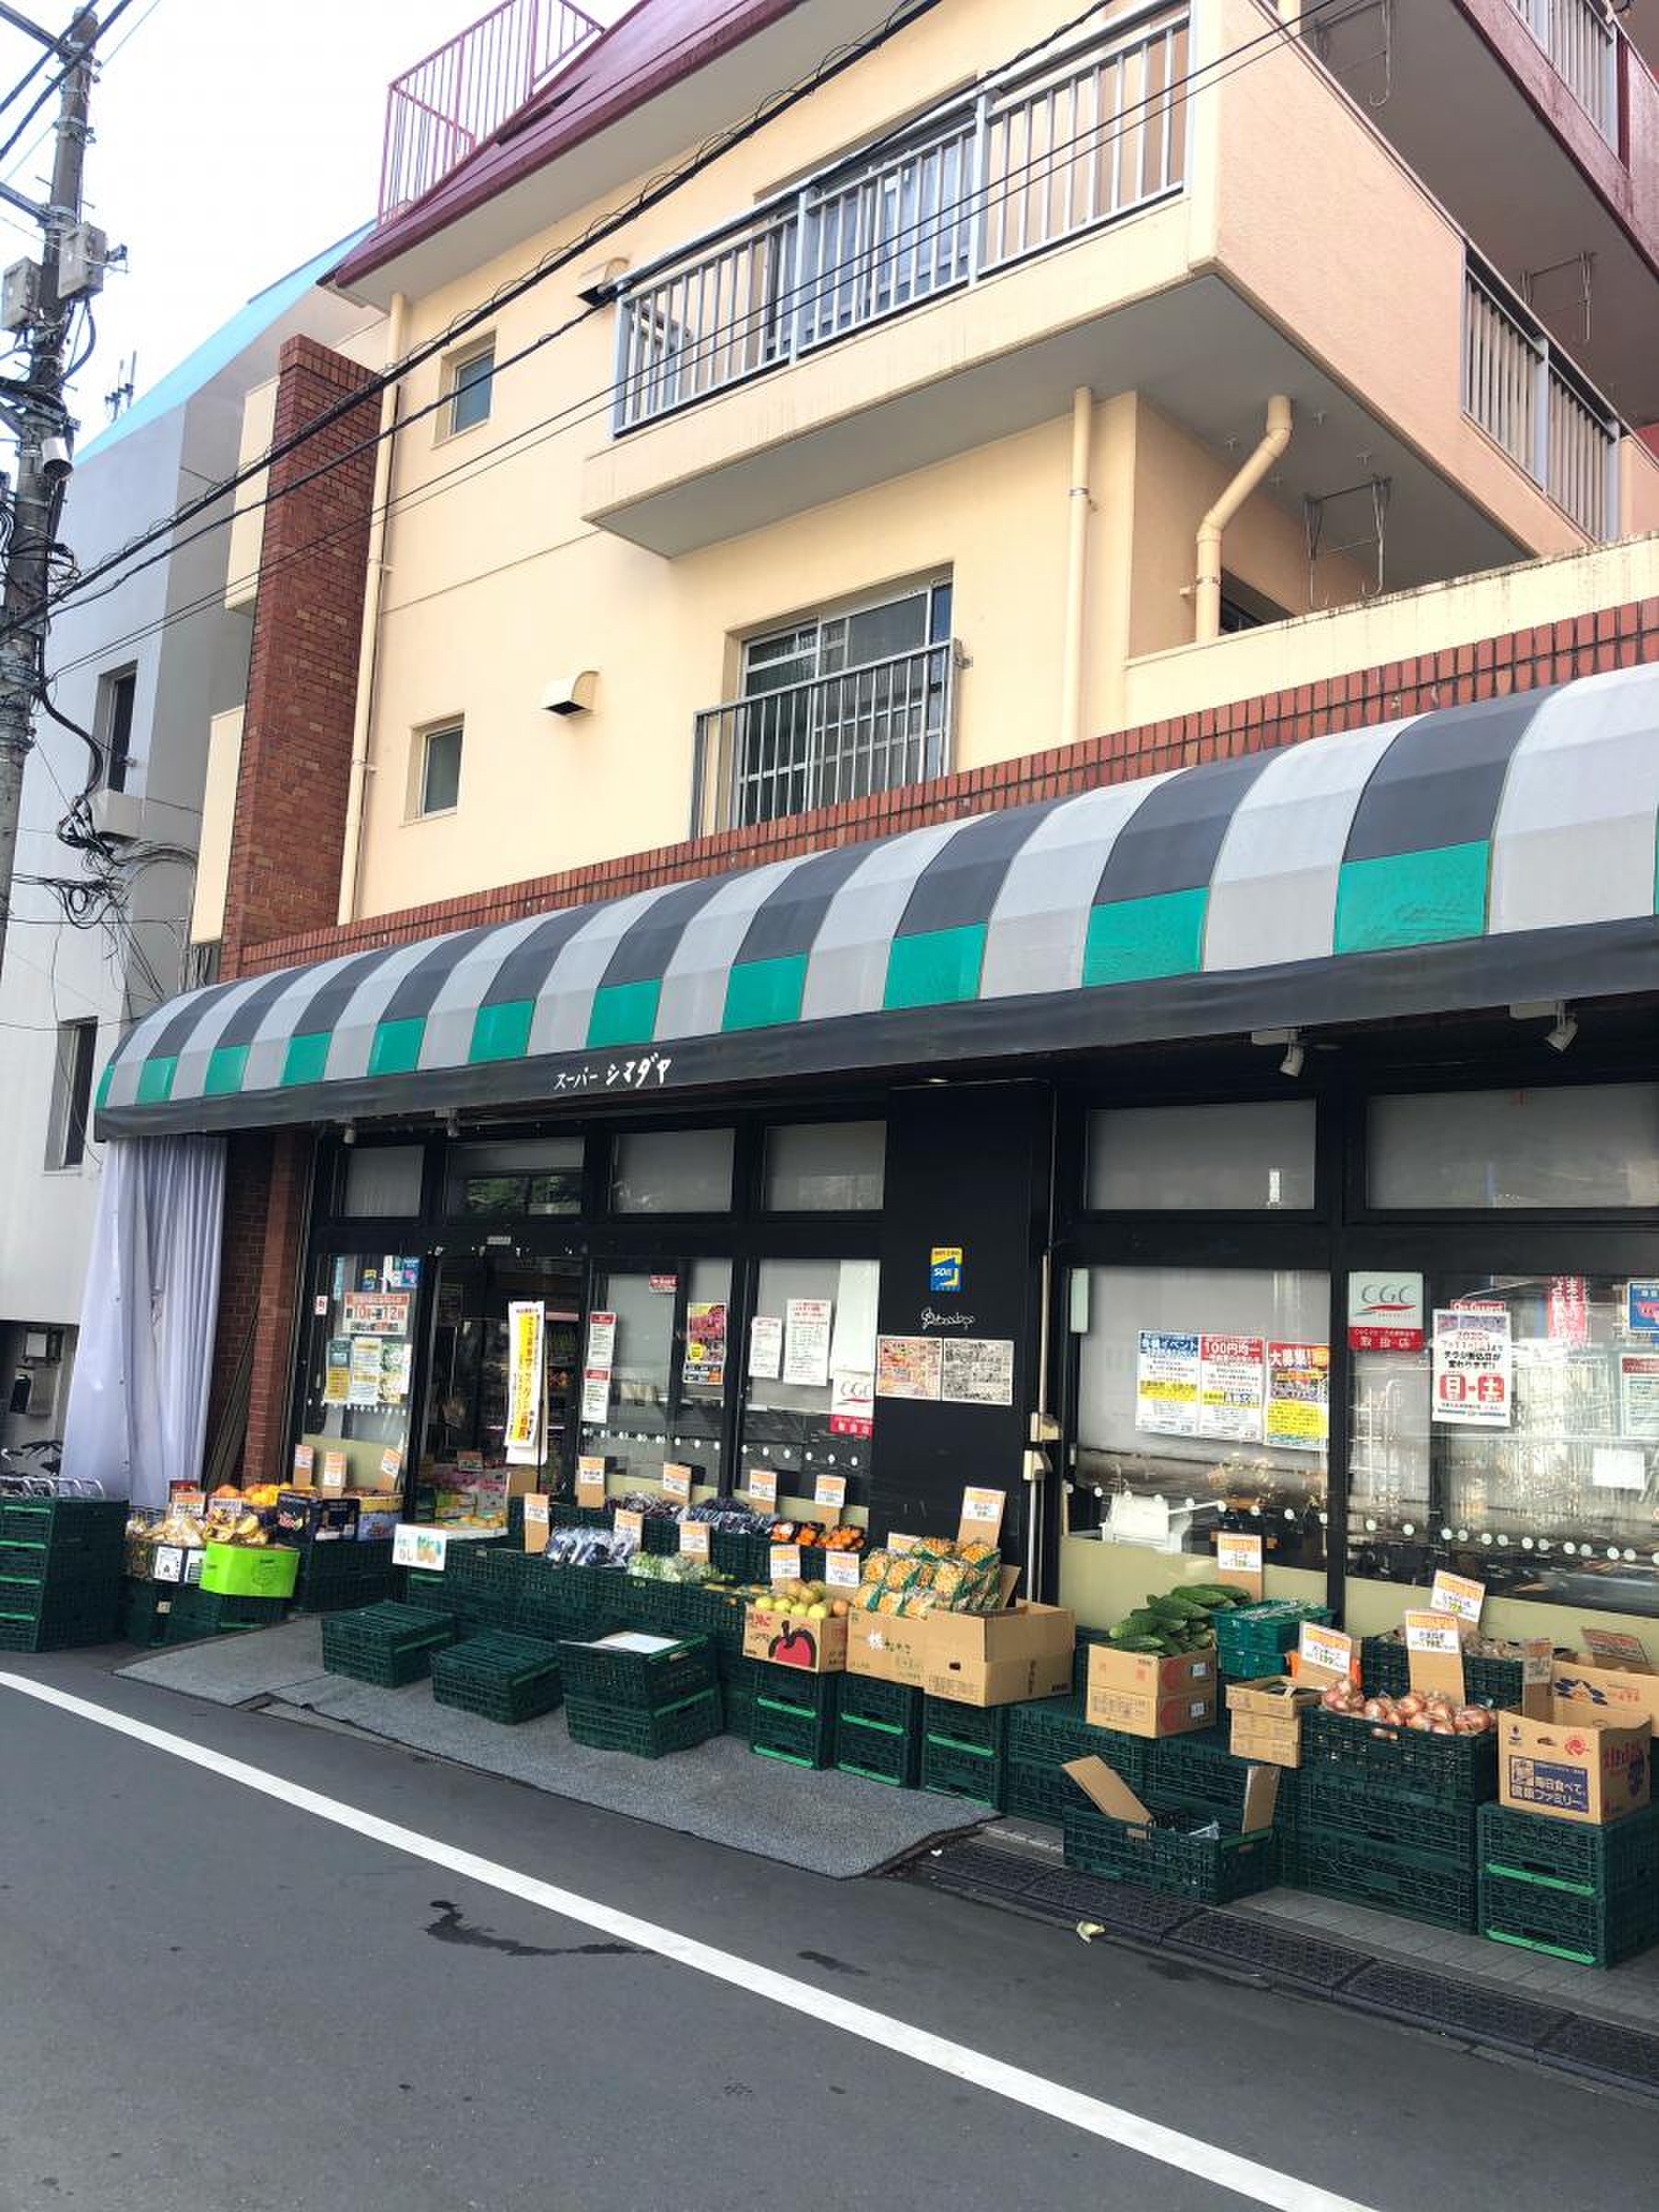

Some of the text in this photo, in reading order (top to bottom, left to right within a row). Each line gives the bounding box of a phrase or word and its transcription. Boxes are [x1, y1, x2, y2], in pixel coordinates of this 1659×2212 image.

[554, 1052, 672, 1090] スーパー シマダヤ
[1361, 1283, 1417, 1304] CGC
